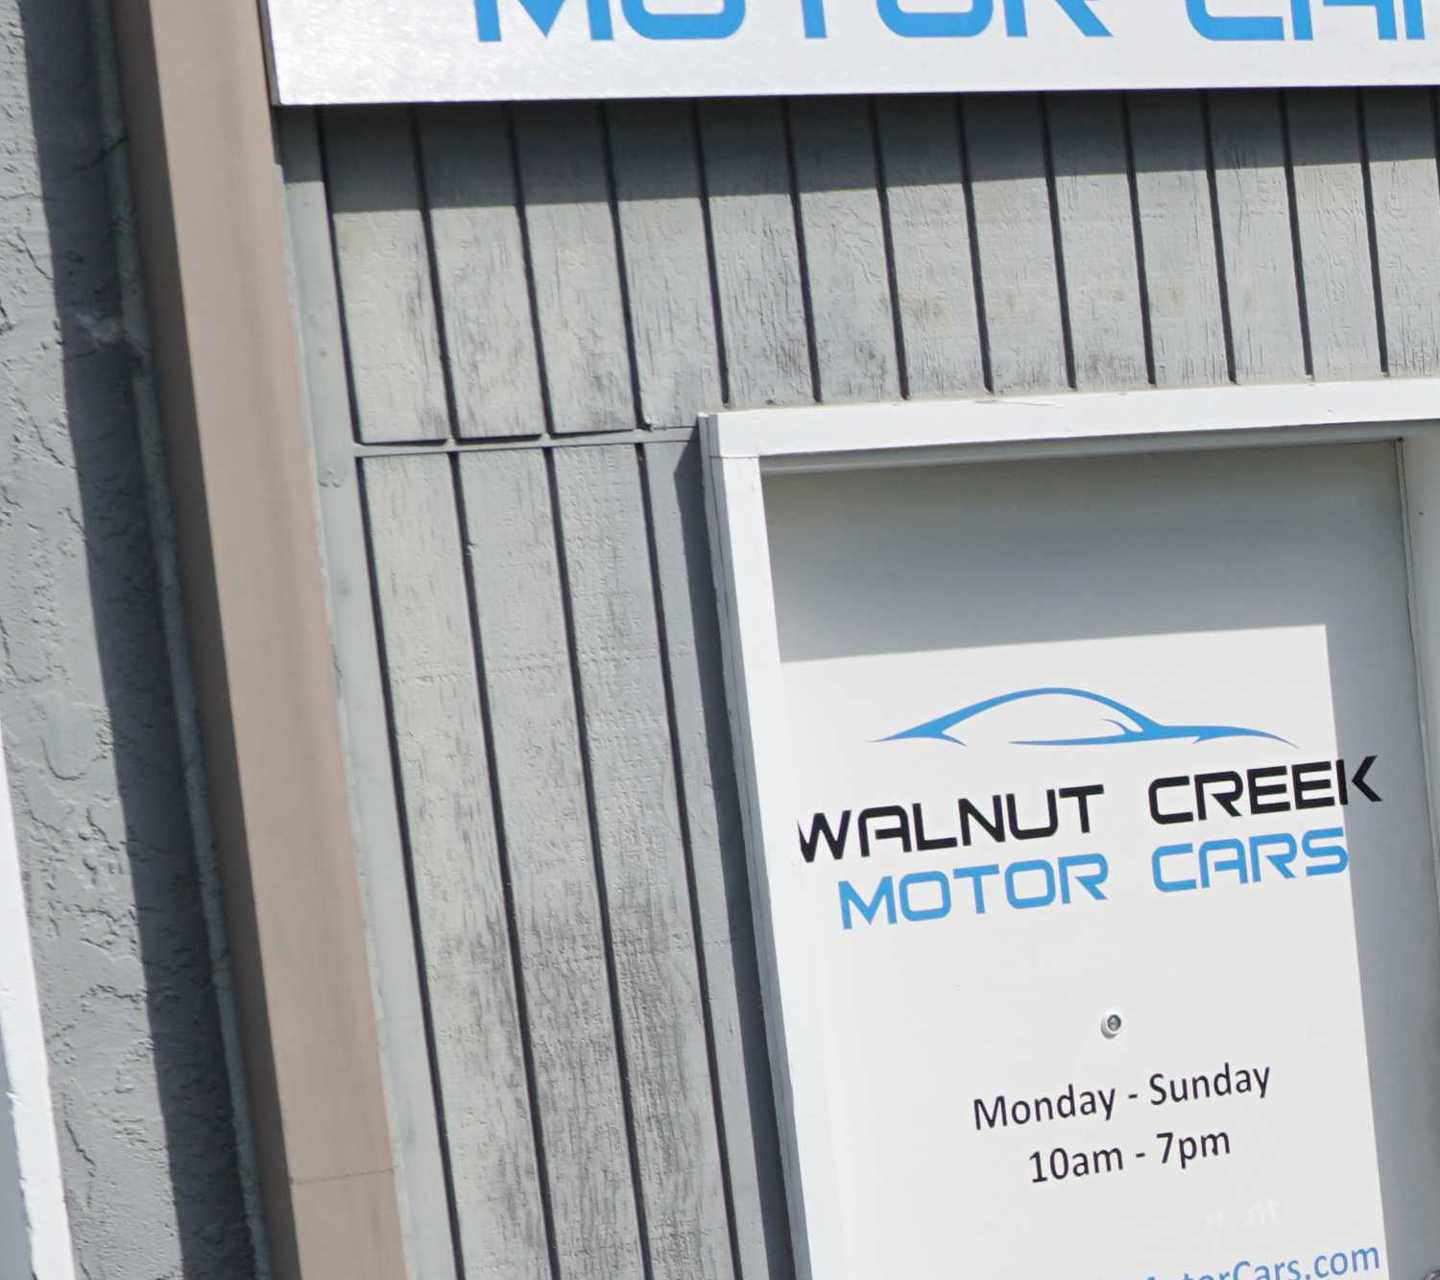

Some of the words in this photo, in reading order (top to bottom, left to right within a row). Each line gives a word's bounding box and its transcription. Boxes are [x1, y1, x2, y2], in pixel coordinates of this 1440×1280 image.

[797, 784, 1105, 863] WALNUT
[1148, 755, 1383, 827] CREEK
[837, 852, 1109, 930] MOTOR
[1150, 826, 1350, 893] CARS
[973, 1083, 1116, 1131] Monday
[1149, 1061, 1272, 1107] Sunday
[1029, 1141, 1124, 1184] 10am
[1156, 1131, 1231, 1171] 7pm
